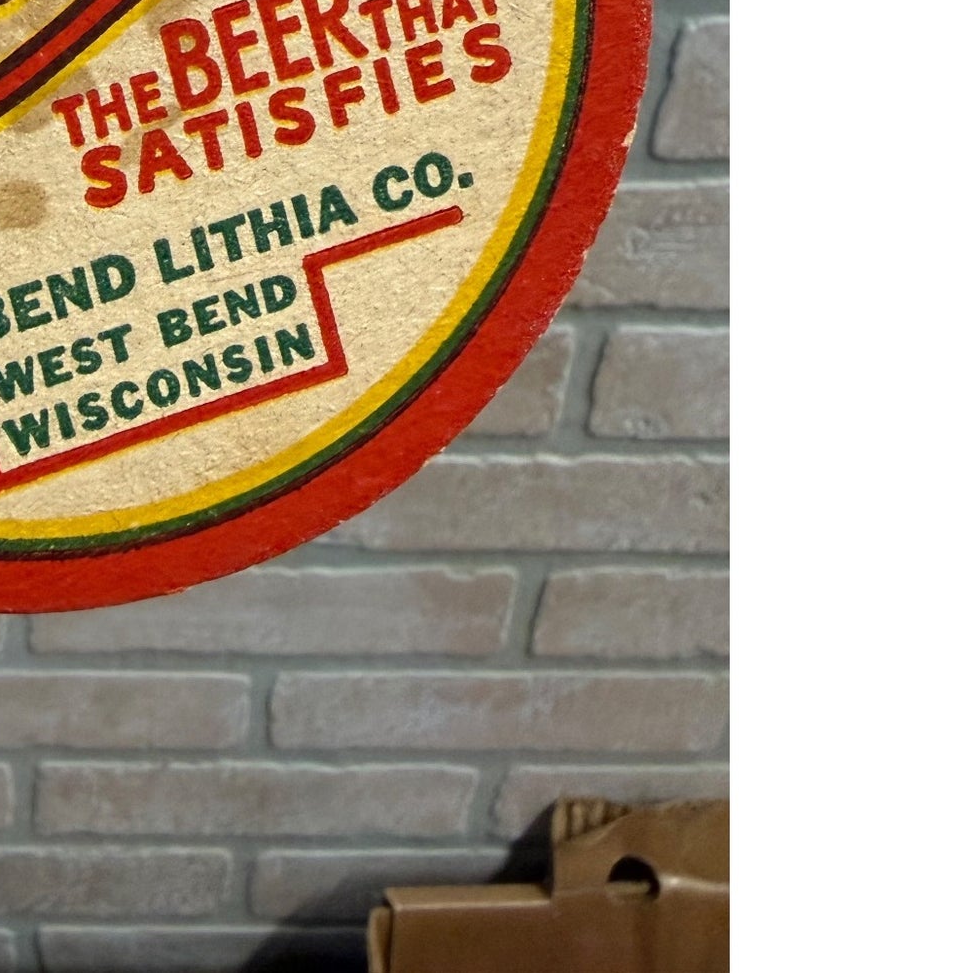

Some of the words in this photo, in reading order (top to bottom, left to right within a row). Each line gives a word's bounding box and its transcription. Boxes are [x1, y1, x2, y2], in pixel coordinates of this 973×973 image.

[51, 71, 169, 148] THE
[80, 22, 512, 209] SATISFIES
[153, 185, 359, 284] LITHIA
[372, 151, 475, 212] CO.
[155, 273, 298, 348] BEND
[1, 322, 316, 457] WISCONSIN
